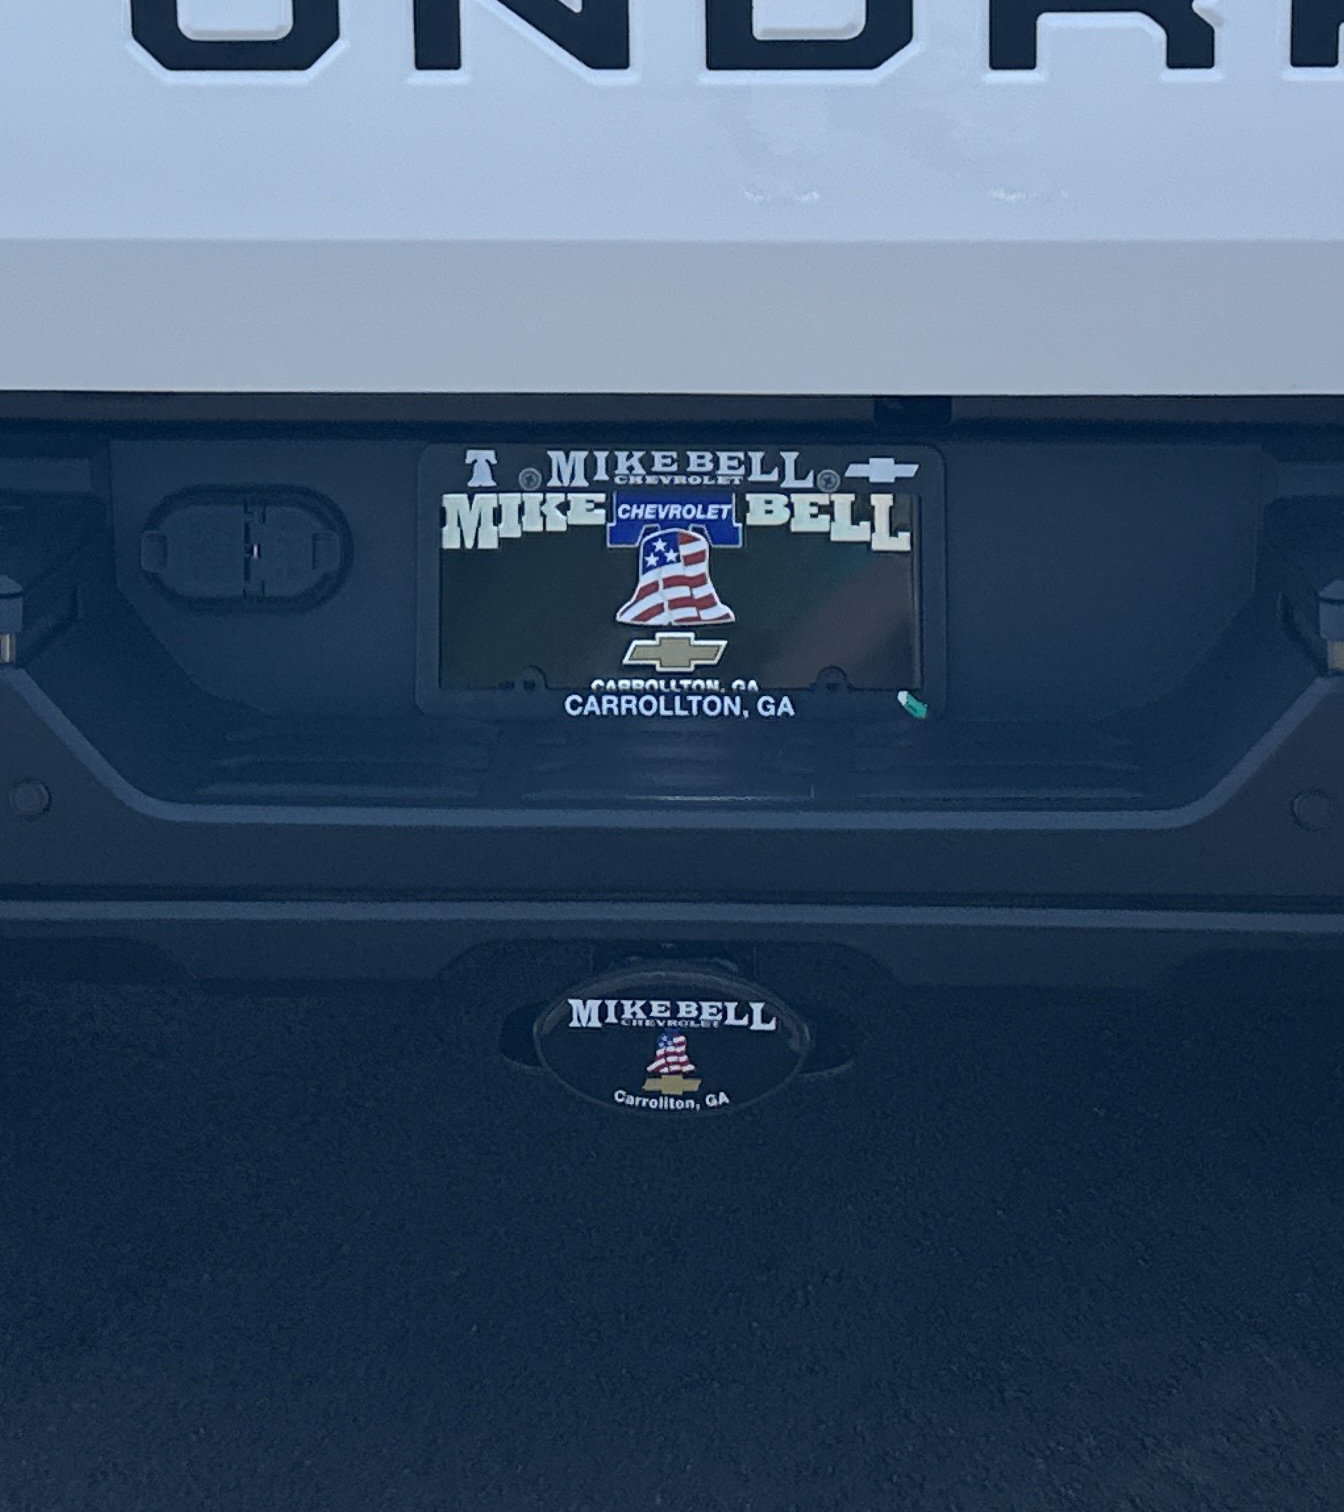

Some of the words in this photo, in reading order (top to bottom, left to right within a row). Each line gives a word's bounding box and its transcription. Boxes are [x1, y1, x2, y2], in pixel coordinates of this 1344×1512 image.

[546, 450, 679, 488] MIKE
[685, 450, 815, 488] BELL
[613, 474, 744, 486] CHEVROLET
[442, 492, 606, 549] MIKE
[616, 503, 734, 521] CHEVROLET
[746, 492, 911, 551] BELL
[563, 693, 750, 719] CARROLLTON,
[756, 695, 796, 717] GA
[567, 998, 672, 1029] MIKE
[675, 999, 778, 1031] BELL
[619, 1018, 720, 1029] CHEVROLET
[613, 1088, 702, 1111] Carrollton,
[704, 1090, 731, 1108] GA
